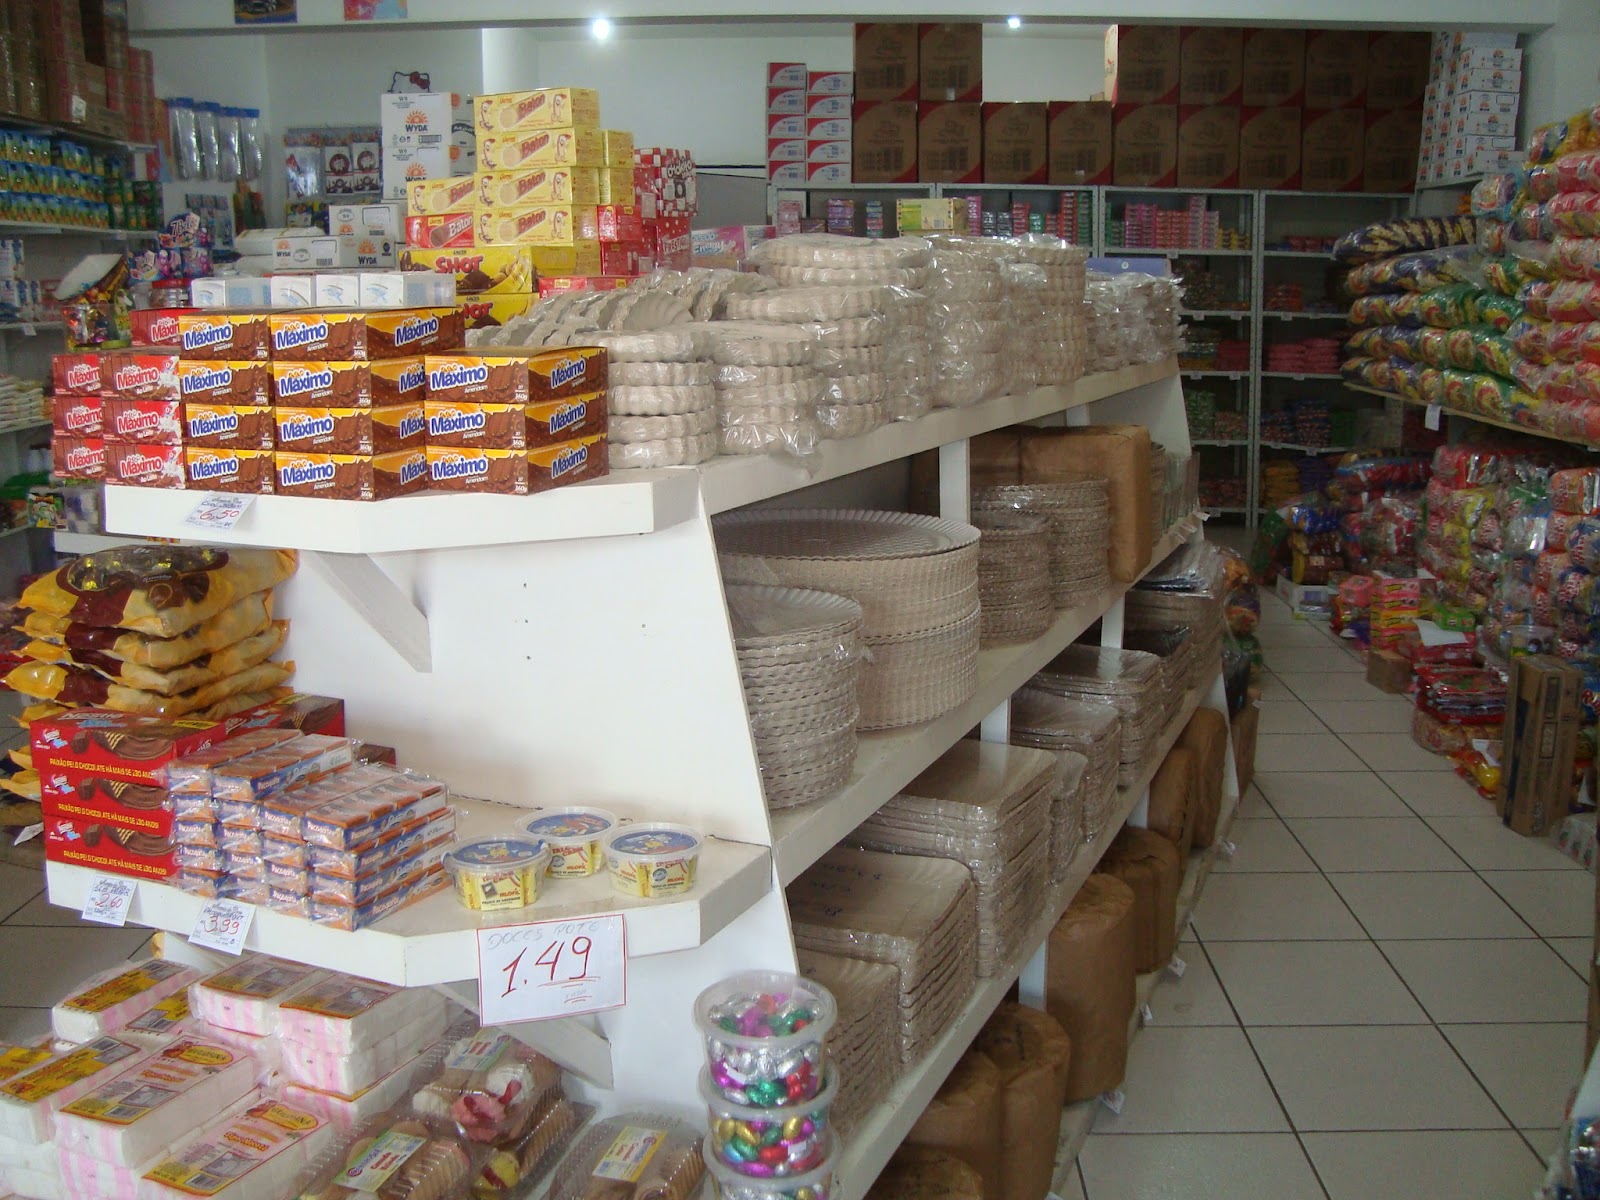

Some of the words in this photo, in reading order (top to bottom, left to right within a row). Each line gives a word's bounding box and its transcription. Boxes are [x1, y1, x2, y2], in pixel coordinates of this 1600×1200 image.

[518, 93, 546, 121] Baton
[405, 124, 428, 132] WYDA
[521, 133, 549, 160] Baton
[518, 171, 546, 197] Baton
[518, 210, 546, 234] Baton
[358, 256, 377, 265] WYDA
[435, 256, 483, 273] SHOT
[68, 366, 100, 388] Maxim
[400, 365, 425, 393] Maxi
[400, 410, 425, 439] Maxi
[401, 456, 427, 485] Maxi
[200, 507, 239, 521] 6,50
[67, 760, 79, 768] PELO
[79, 762, 105, 773] CHOCOLATE
[112, 767, 124, 775] MAIS
[124, 768, 132, 776] DE
[85, 808, 111, 819] CHOCOLATE
[117, 815, 129, 823] MAIS
[79, 853, 91, 862] PELO
[91, 855, 118, 866] CHOCOLATE
[125, 861, 136, 870] MAIS
[136, 863, 143, 871] DE
[554, 921, 599, 936] POTE
[501, 936, 592, 998] 1.49
